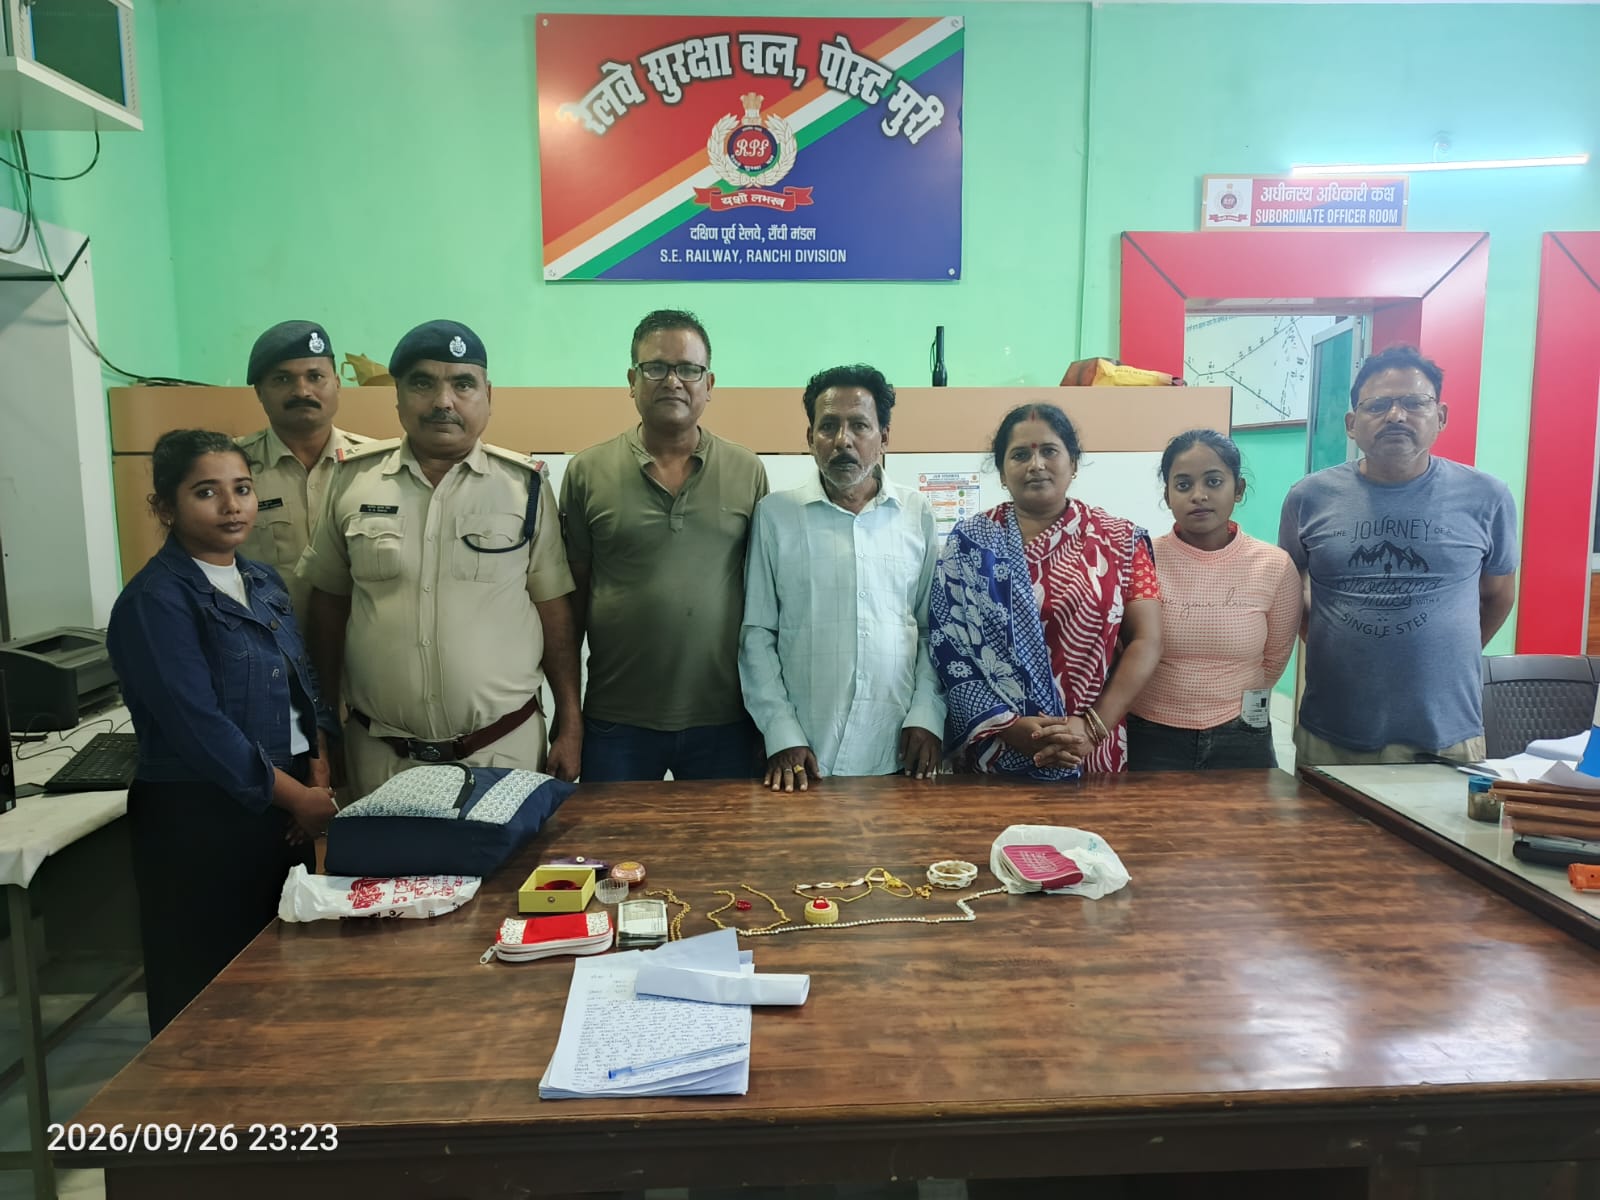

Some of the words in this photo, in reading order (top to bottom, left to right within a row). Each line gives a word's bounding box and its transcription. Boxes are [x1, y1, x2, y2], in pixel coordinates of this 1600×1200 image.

[640, 35, 732, 103] सुरक्षा
[739, 34, 806, 88] बल,
[820, 35, 893, 105] पोस्ट
[881, 80, 945, 144] मुरी
[1260, 182, 1313, 202] अधीनस्थ
[1316, 182, 1369, 202] अधिकारी
[1371, 186, 1395, 202] कक्ष
[1255, 208, 1325, 224] SUBORDINATE
[1327, 208, 1366, 223] OFFICER
[1368, 208, 1398, 223] ROOM
[690, 224, 718, 240] दक्षिण
[721, 224, 736, 244] पूर्व
[738, 224, 765, 243] रेलवे,
[790, 225, 816, 240] मंडल
[660, 249, 682, 263] S.E.
[686, 249, 742, 264] RAILWAY,
[747, 249, 792, 263] RANCHI
[795, 249, 847, 263] DIVISION
[1350, 515, 1432, 543] JOURNEY
[1341, 612, 1390, 639] SINGLE
[1396, 611, 1428, 634] STEP
